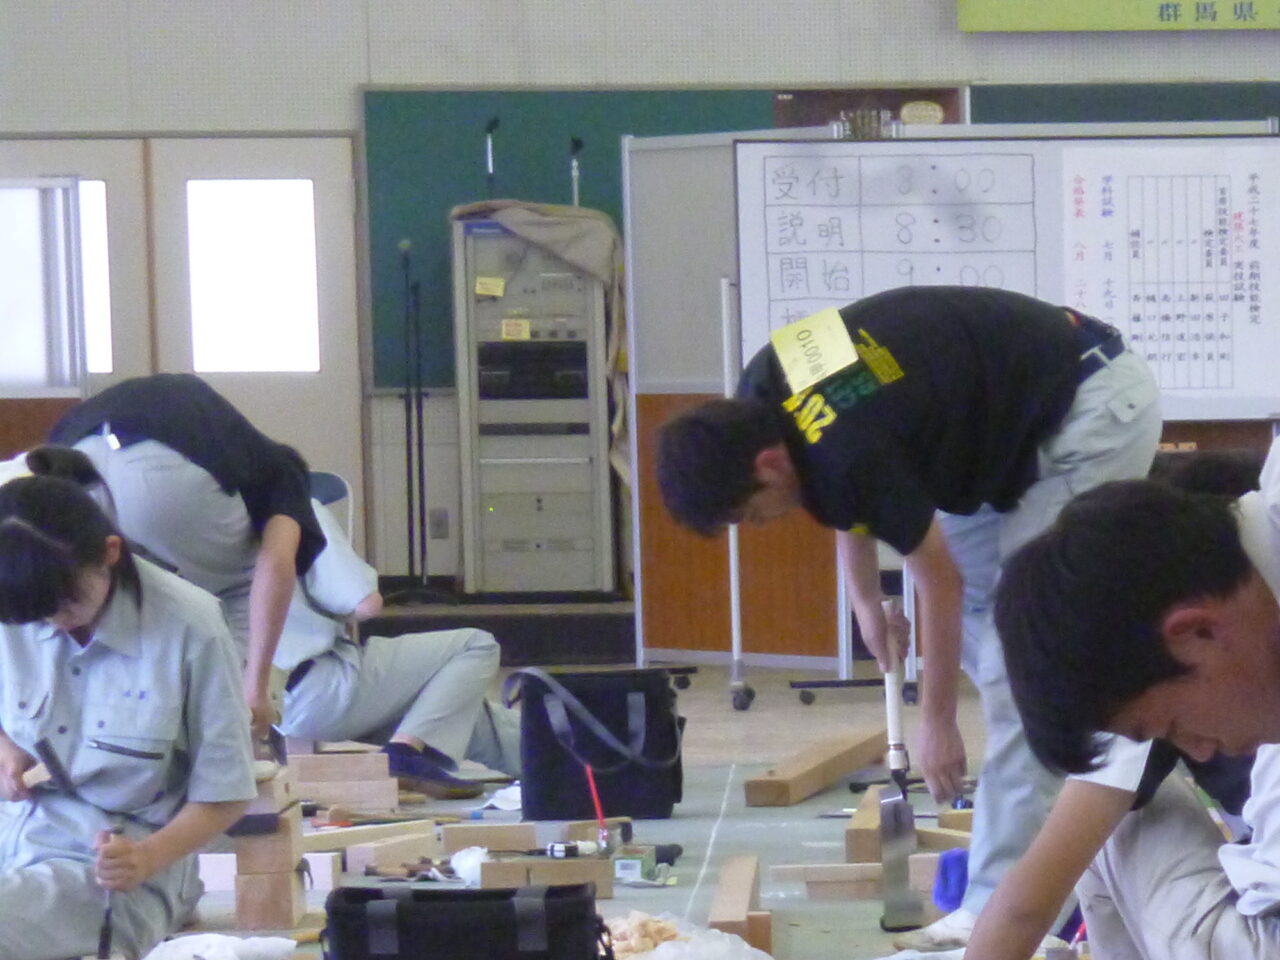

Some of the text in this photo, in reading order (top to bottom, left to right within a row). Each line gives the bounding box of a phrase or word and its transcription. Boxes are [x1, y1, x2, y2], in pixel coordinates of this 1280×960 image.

[771, 166, 845, 200] 受付
[777, 211, 845, 247] 説明
[895, 212, 1003, 244] 8:30
[779, 257, 850, 294] 開始
